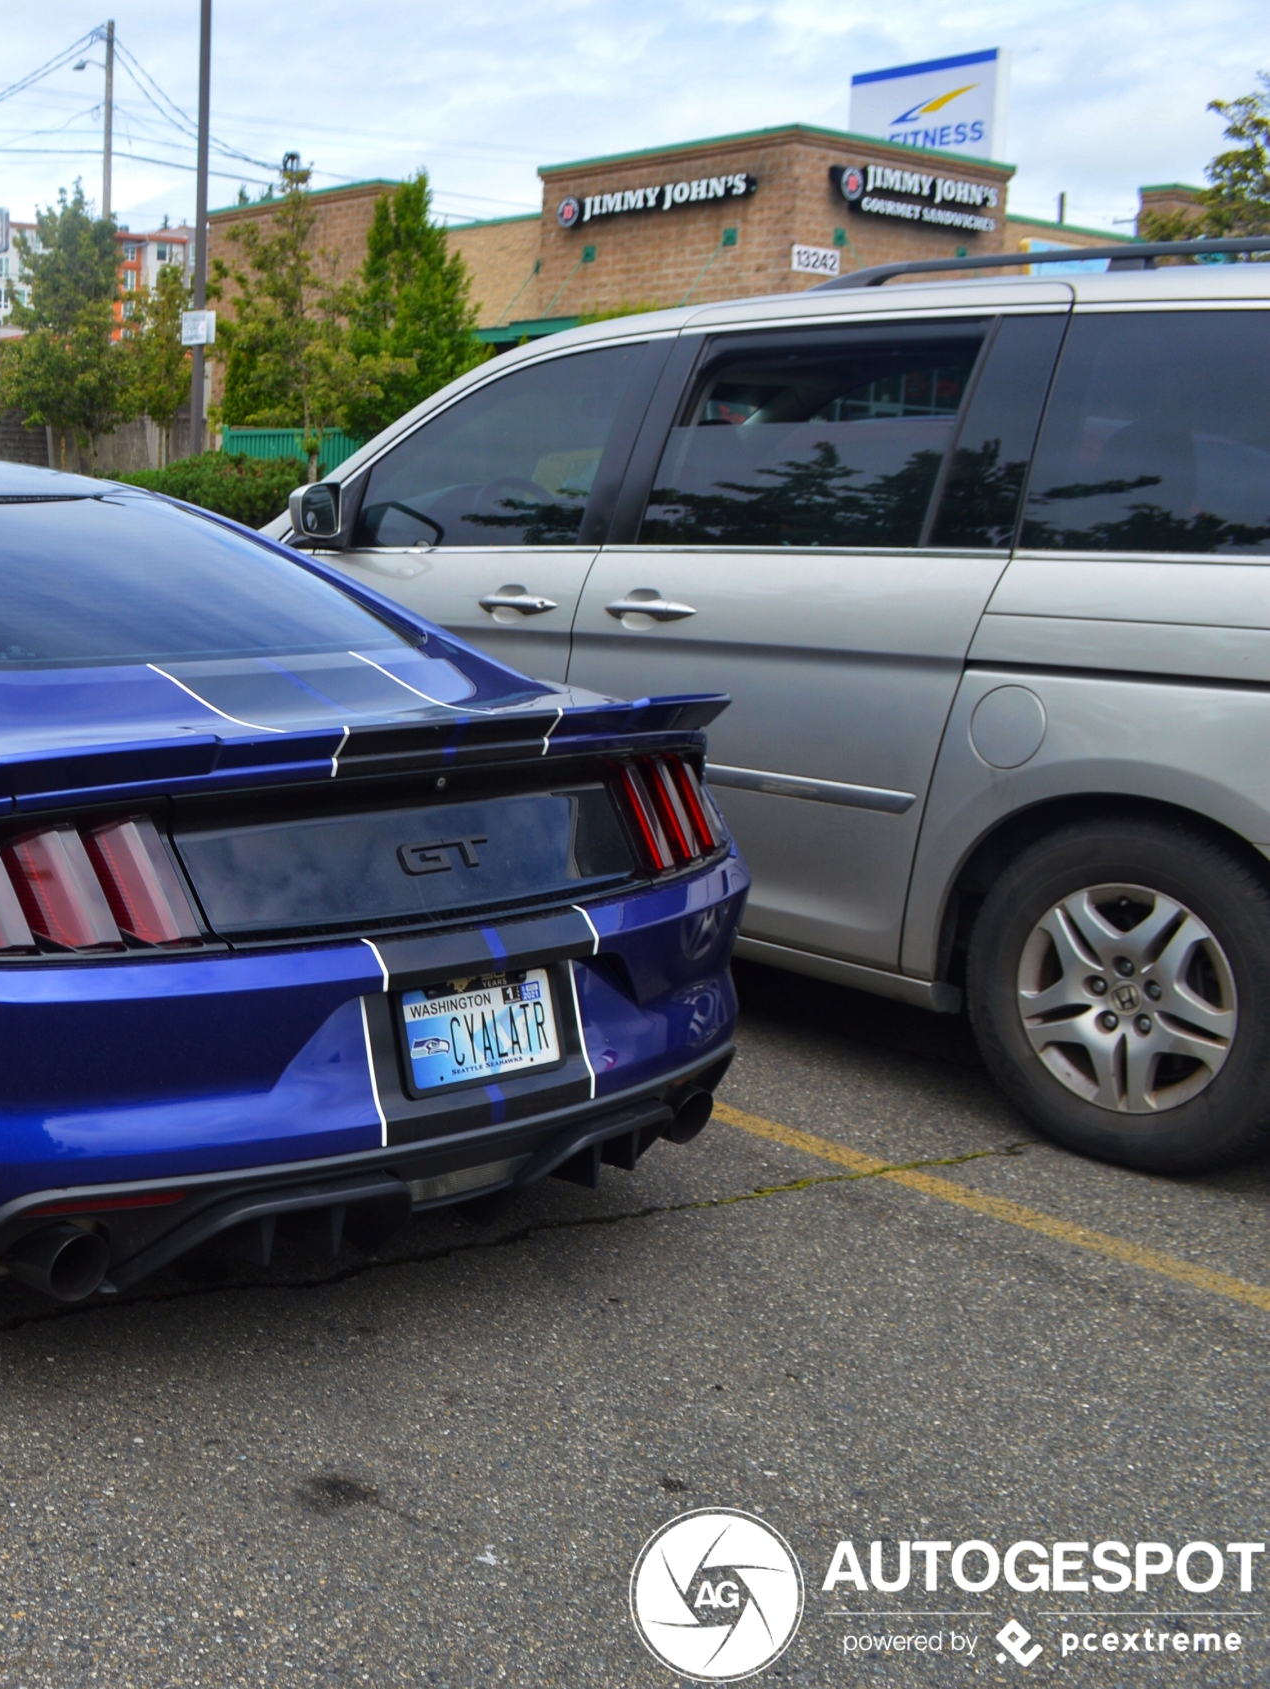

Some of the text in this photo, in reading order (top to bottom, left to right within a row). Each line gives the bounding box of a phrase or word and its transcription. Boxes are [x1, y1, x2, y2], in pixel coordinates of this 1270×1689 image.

[582, 186, 661, 223] JIMMY
[661, 173, 747, 211] JOHN'S
[866, 164, 933, 197] JIMMY
[934, 178, 999, 208] JOHN'S
[861, 196, 996, 233] GOURMET SANDWICHES
[796, 248, 838, 272] 13242
[396, 835, 488, 877] GT
[482, 978, 508, 988] YEARS
[410, 992, 492, 1019] WASHINGTON
[450, 1001, 550, 1067] CYALATR
